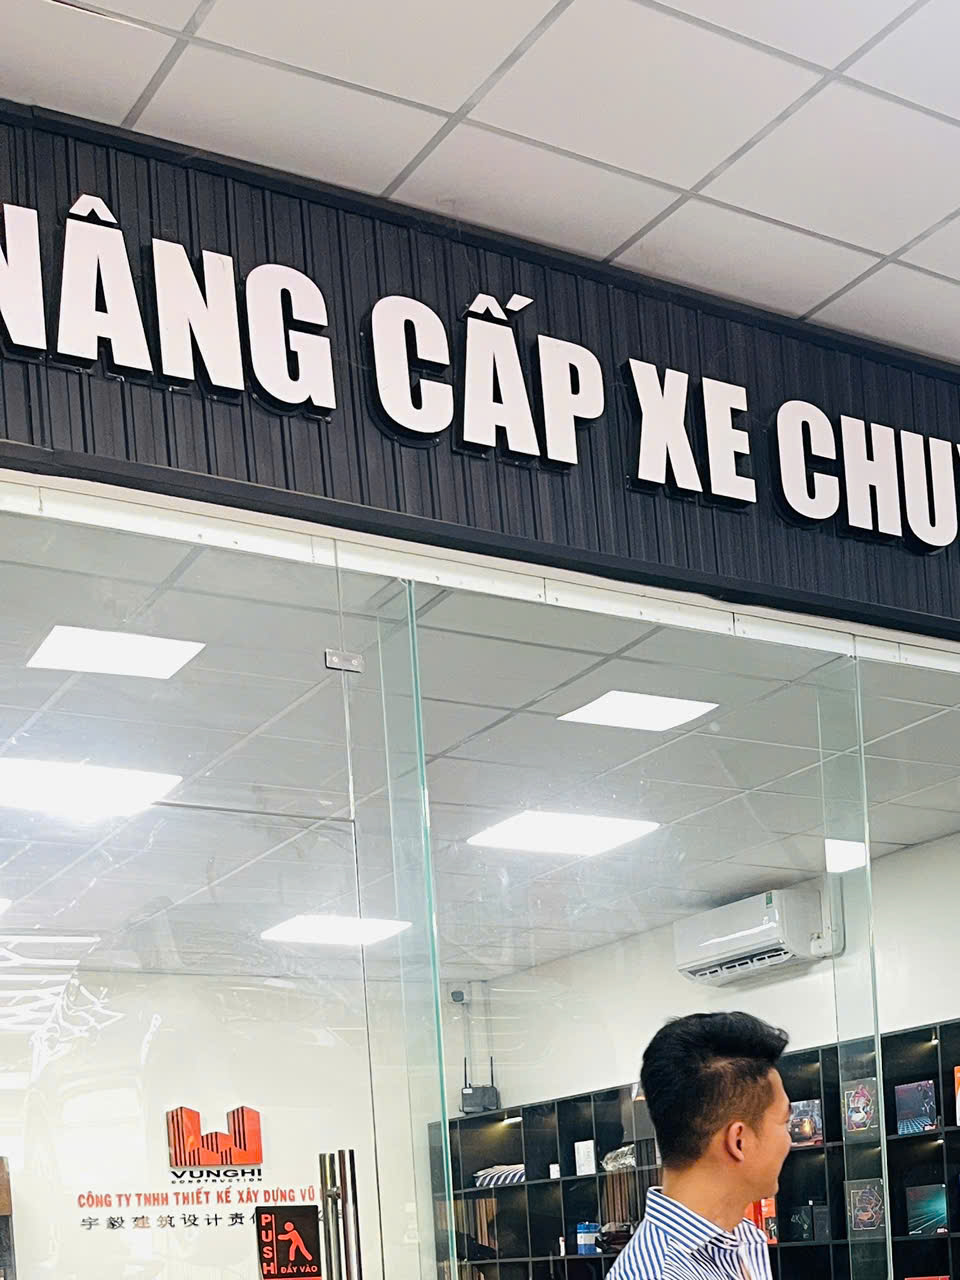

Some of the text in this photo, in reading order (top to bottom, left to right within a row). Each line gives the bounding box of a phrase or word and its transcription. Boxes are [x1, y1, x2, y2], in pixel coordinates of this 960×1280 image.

[371, 292, 605, 466] CẤP
[627, 357, 759, 504] XE
[170, 1168, 263, 1180] VUNGHI
[170, 1177, 263, 1185] CONSTRUCTION
[77, 1190, 113, 1208] CÔNG
[116, 1192, 132, 1207] TY
[135, 1191, 169, 1206] TNHH
[173, 1186, 211, 1205] THIẾT
[216, 1184, 232, 1204] KẾ
[237, 1186, 259, 1204] XÂY
[263, 1186, 296, 1206] DỰNG
[260, 1213, 276, 1275] PUSH
[299, 1263, 318, 1273] VÀO
